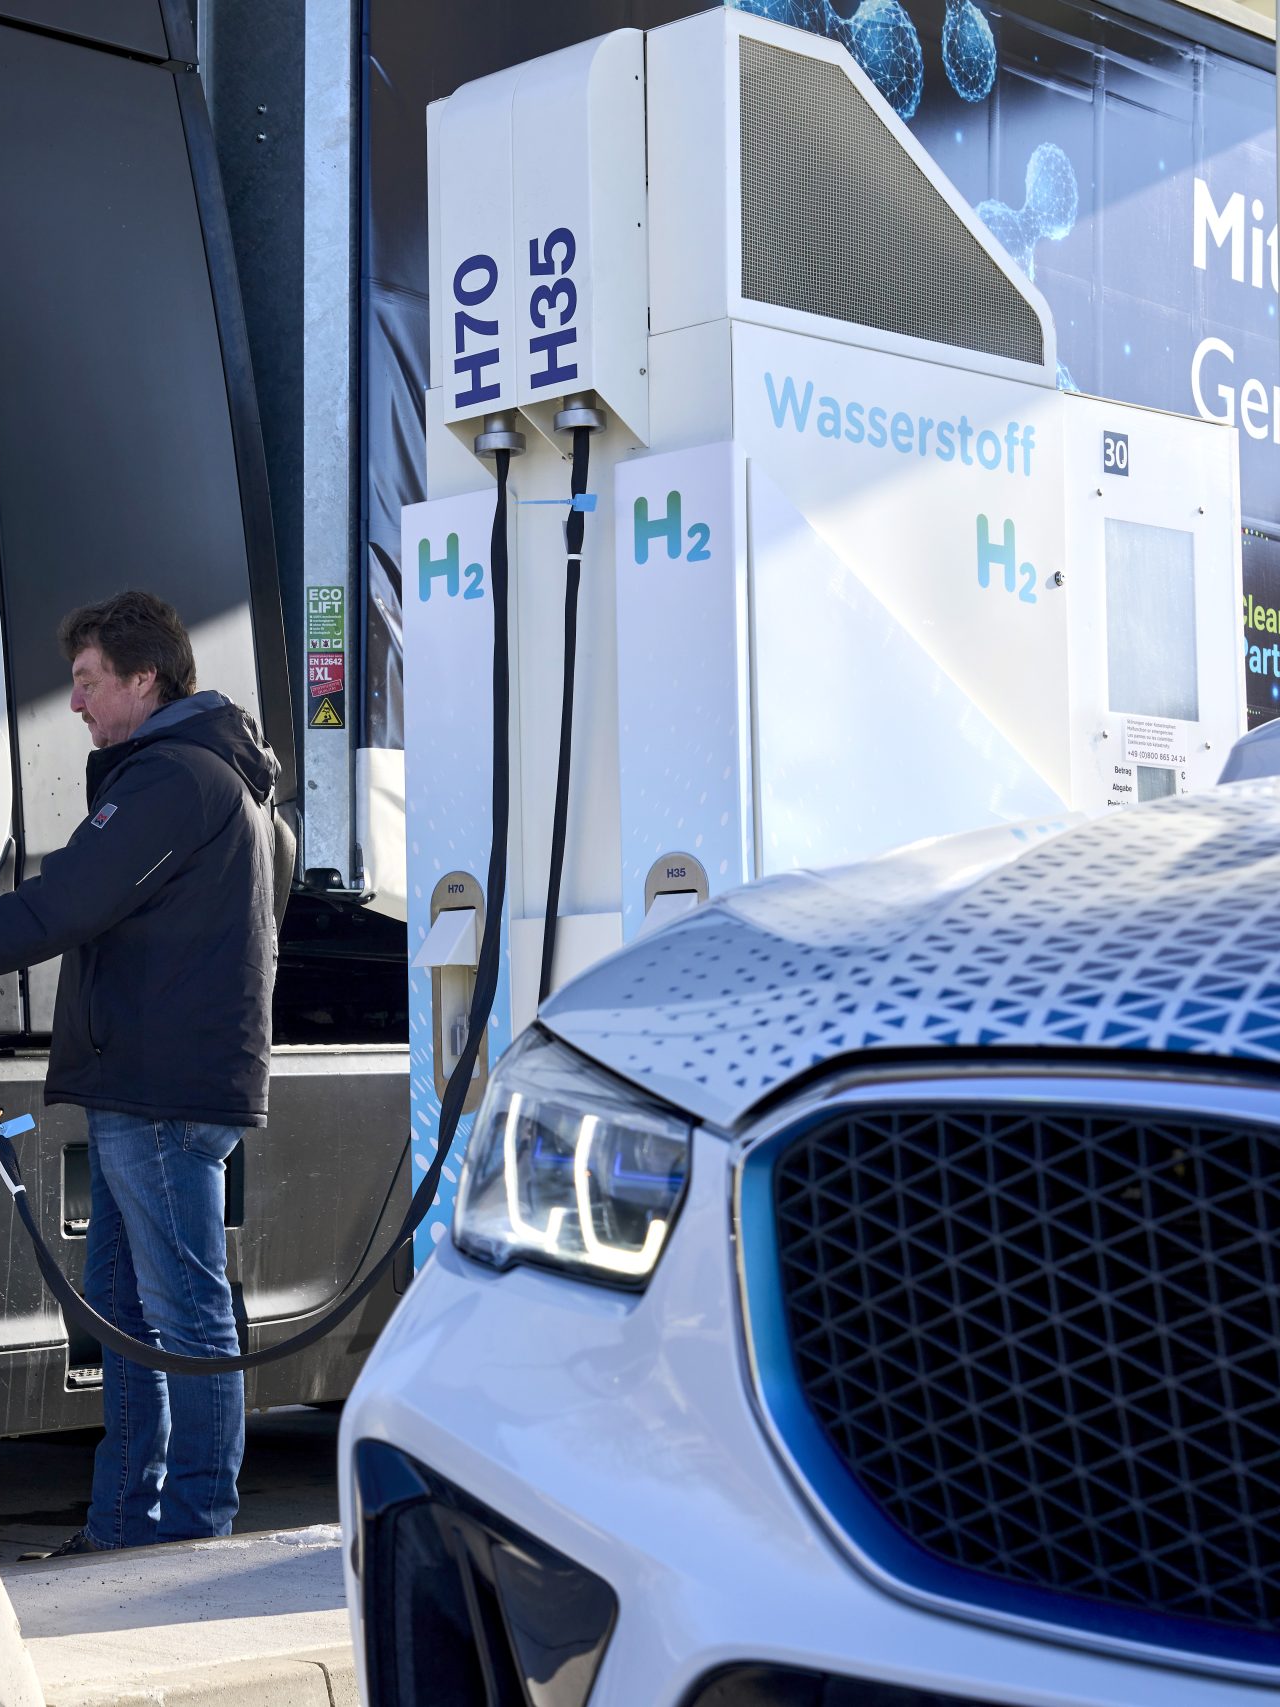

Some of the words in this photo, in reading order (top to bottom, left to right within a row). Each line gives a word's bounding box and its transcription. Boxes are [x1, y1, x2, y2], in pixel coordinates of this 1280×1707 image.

[530, 227, 578, 389] H35
[453, 254, 500, 408] H70
[764, 372, 1036, 477] Wasserstoff
[1105, 438, 1127, 469] 30
[309, 588, 342, 600] ECO
[309, 602, 342, 613] LIFT
[1243, 594, 1280, 634] lea
[309, 658, 319, 666] EN
[320, 658, 342, 666] 12642
[315, 667, 332, 681] XL
[1114, 766, 1132, 776] Betrag
[1112, 783, 1132, 792] Abgabe
[666, 868, 686, 879] H35
[448, 884, 464, 894] H70
